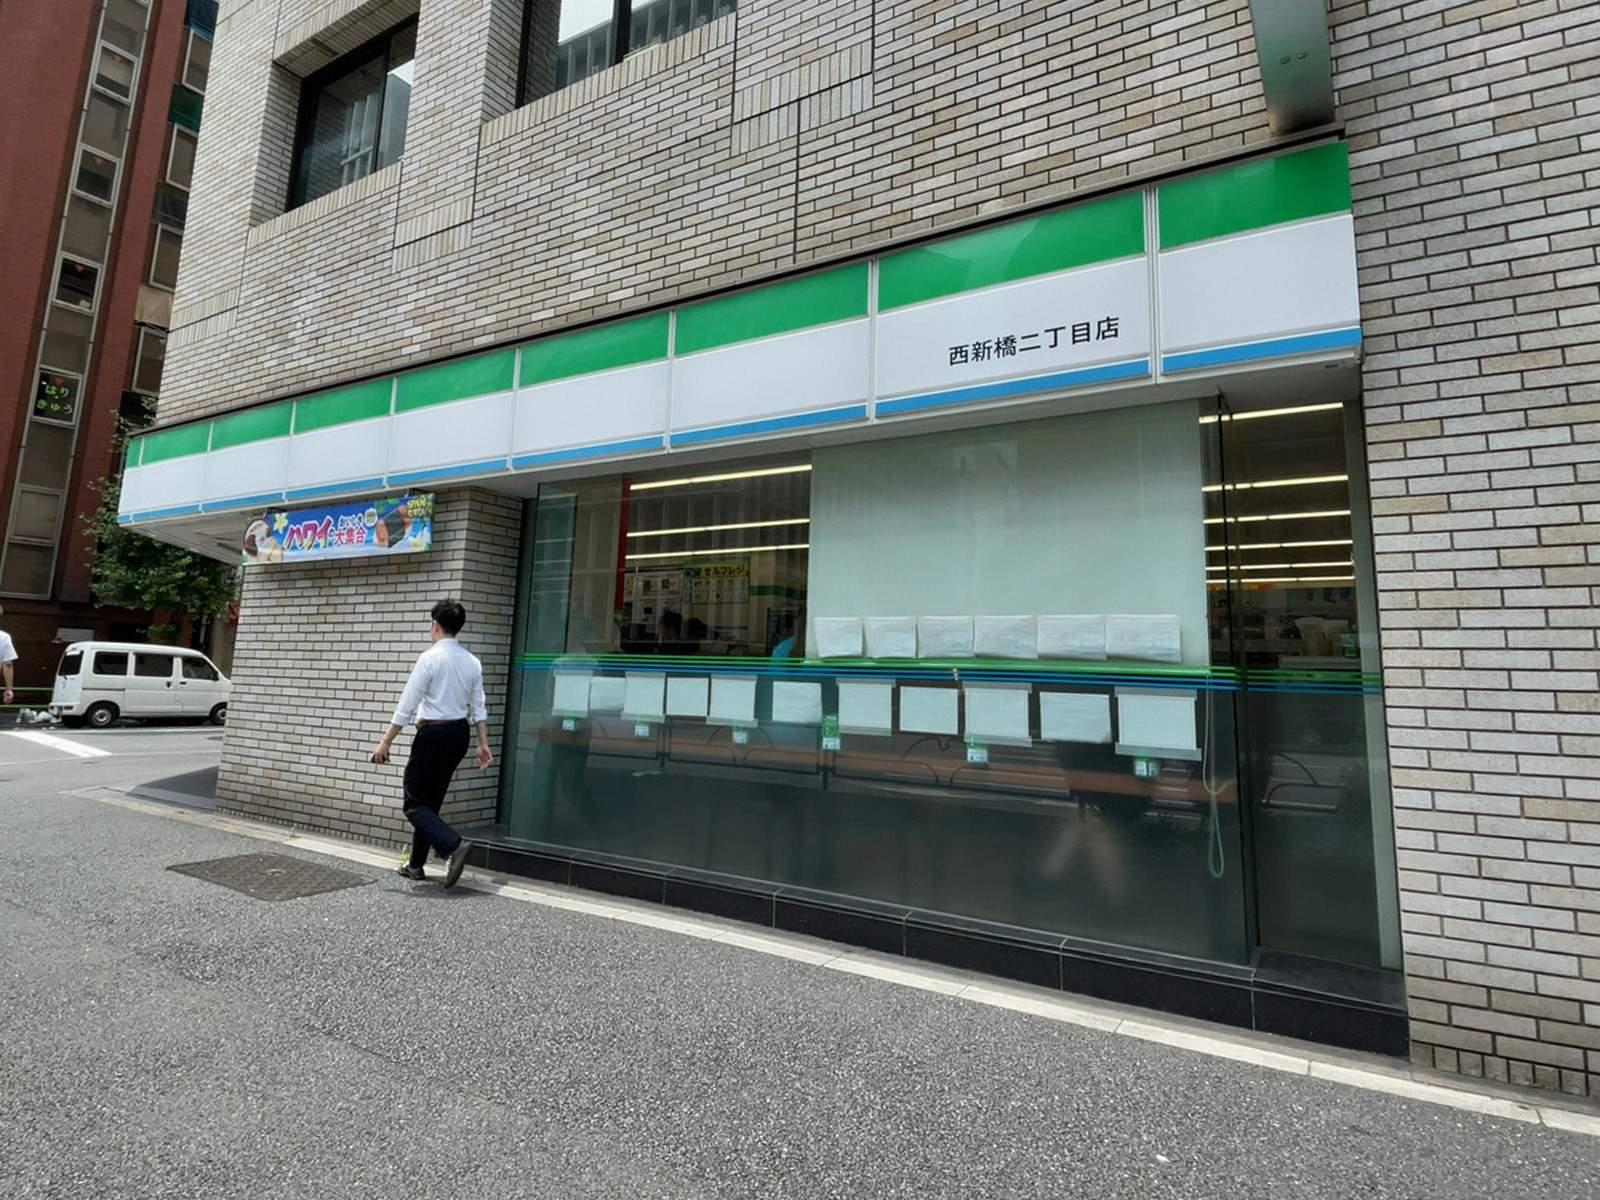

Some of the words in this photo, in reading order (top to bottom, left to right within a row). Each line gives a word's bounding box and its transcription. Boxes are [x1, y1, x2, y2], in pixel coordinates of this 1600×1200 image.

[948, 316, 1120, 366] 西新橋二丁目店
[45, 384, 69, 397] はり
[334, 526, 366, 546] 大集合
[704, 565, 746, 577] セルフレジ
